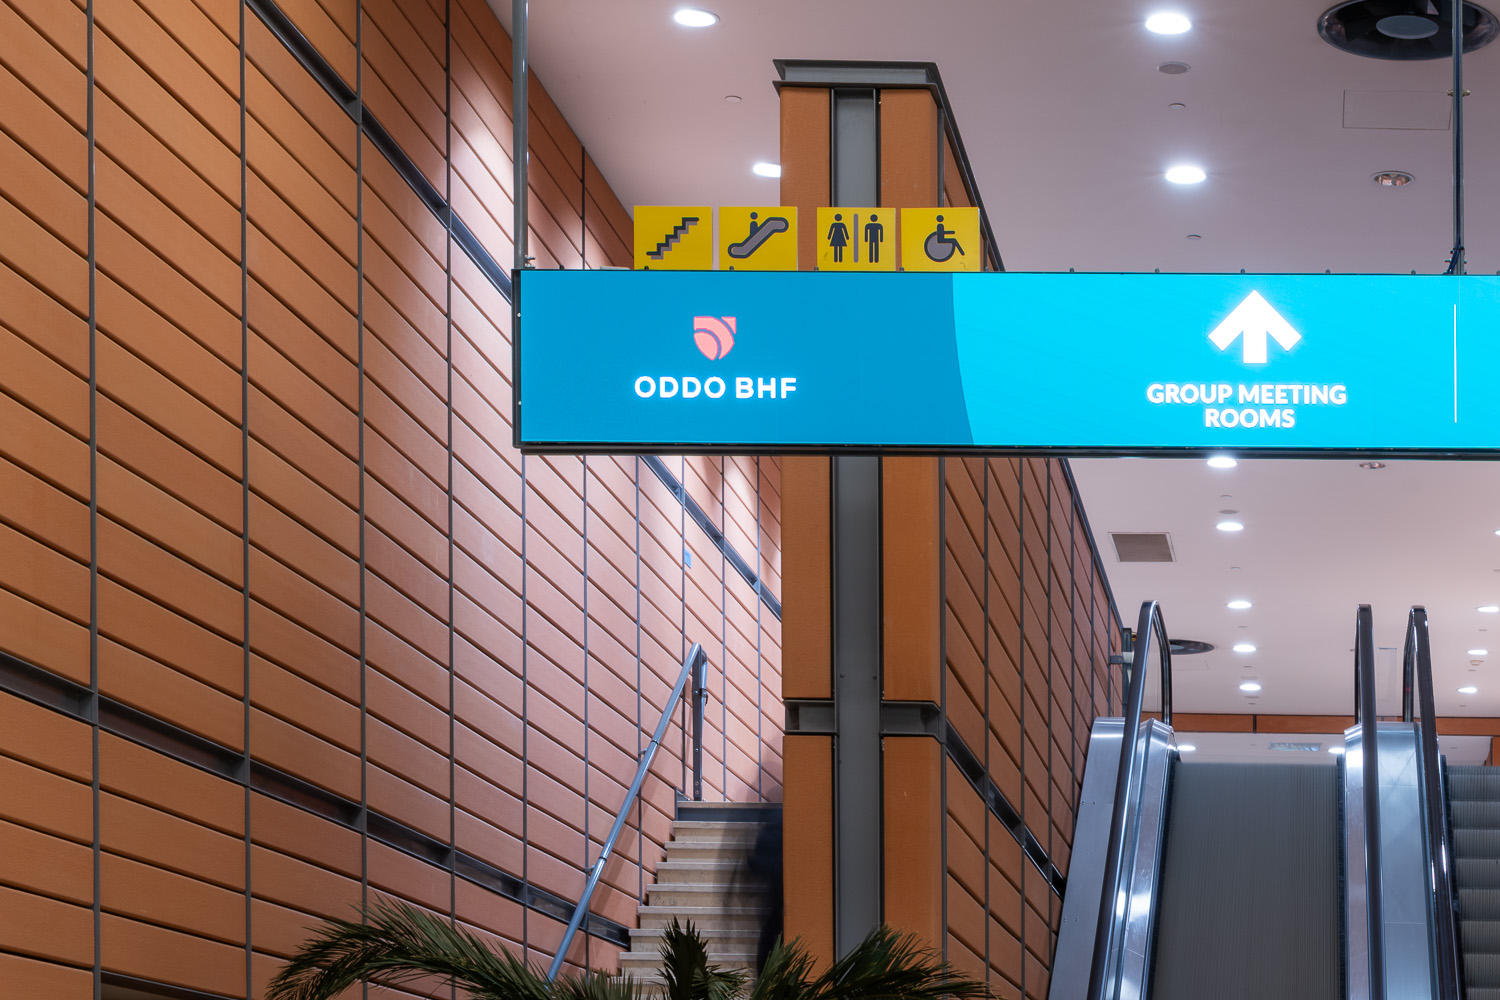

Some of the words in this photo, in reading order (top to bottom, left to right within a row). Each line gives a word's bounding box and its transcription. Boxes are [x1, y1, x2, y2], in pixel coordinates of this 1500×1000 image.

[634, 375, 726, 399] ODDO
[735, 377, 797, 399] BHF
[1146, 383, 1233, 404] GROUP
[1238, 384, 1347, 405] MEETING
[1204, 408, 1296, 429] ROOMS
